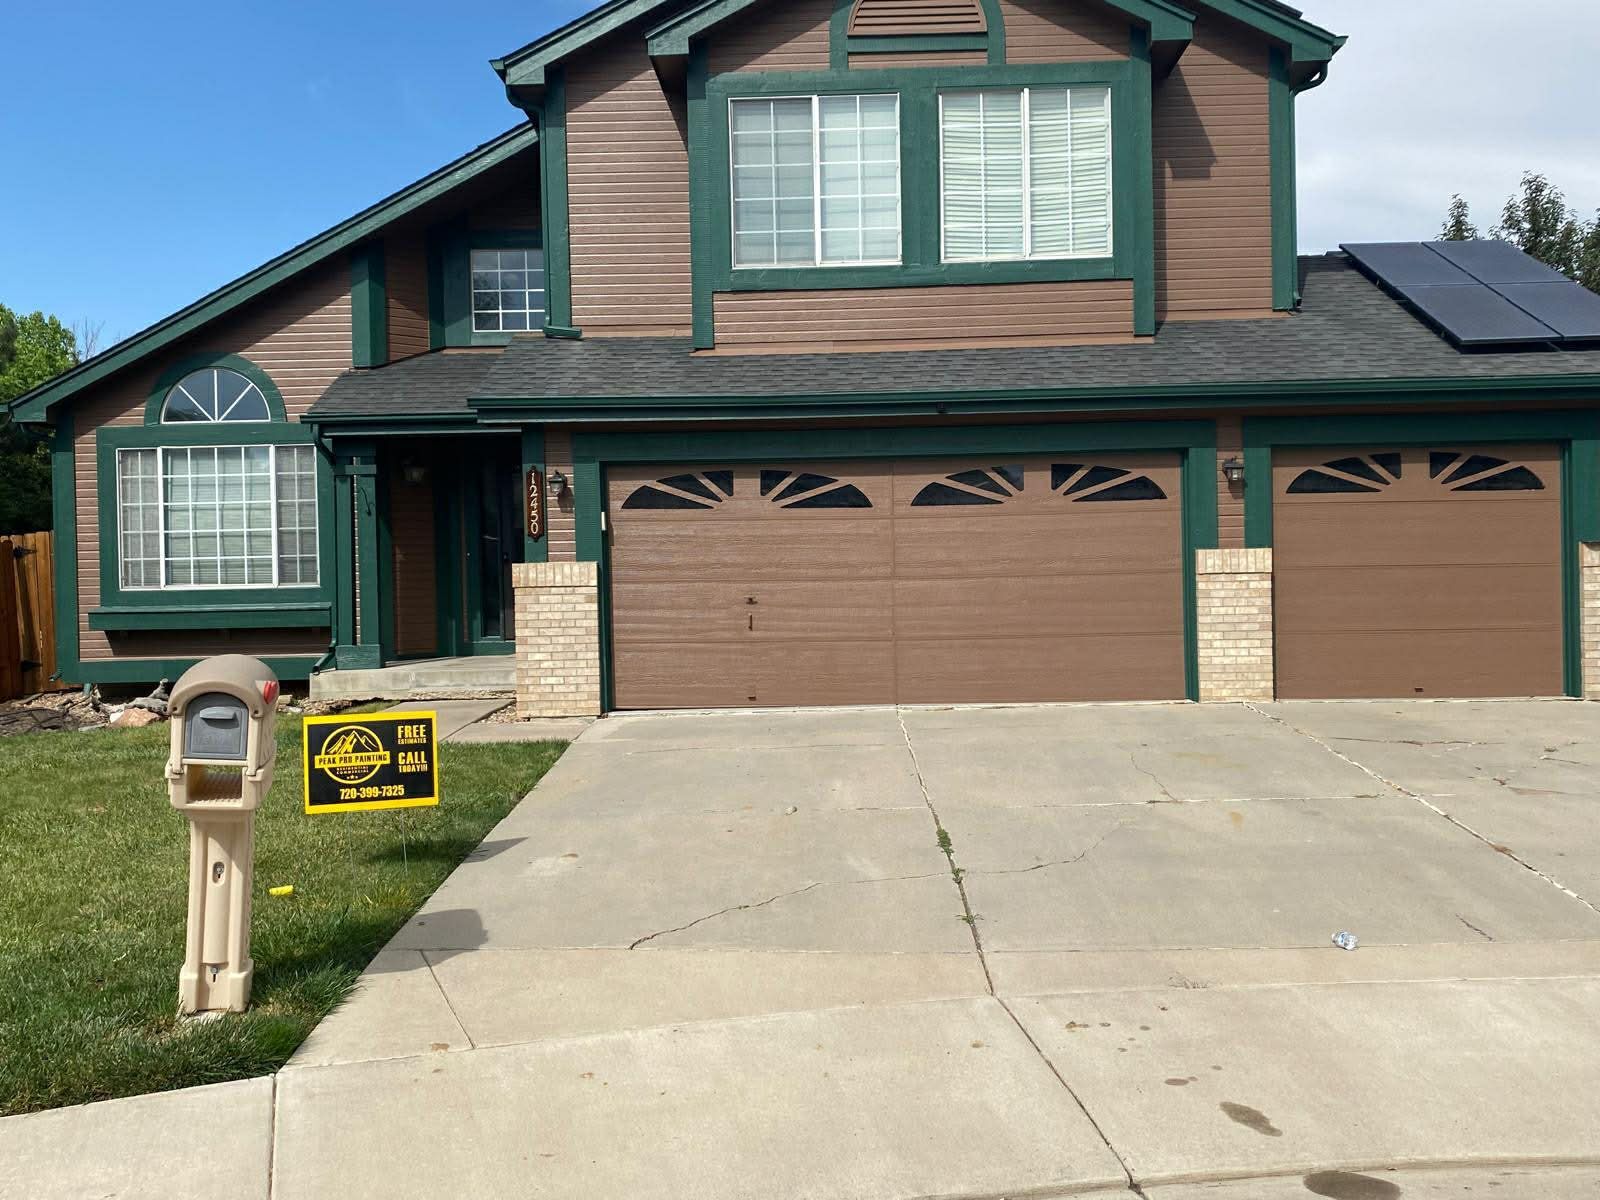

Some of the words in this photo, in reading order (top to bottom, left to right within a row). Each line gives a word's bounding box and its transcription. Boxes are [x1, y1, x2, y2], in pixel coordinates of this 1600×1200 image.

[529, 472, 539, 534] 12450
[397, 724, 427, 738] FREE
[397, 737, 427, 745] ESTIMATES
[318, 756, 337, 765] PEAK
[339, 755, 353, 764] PRO
[355, 753, 388, 763] PAINTING
[398, 751, 427, 764] CALL
[339, 785, 405, 800] 720-399-7325
